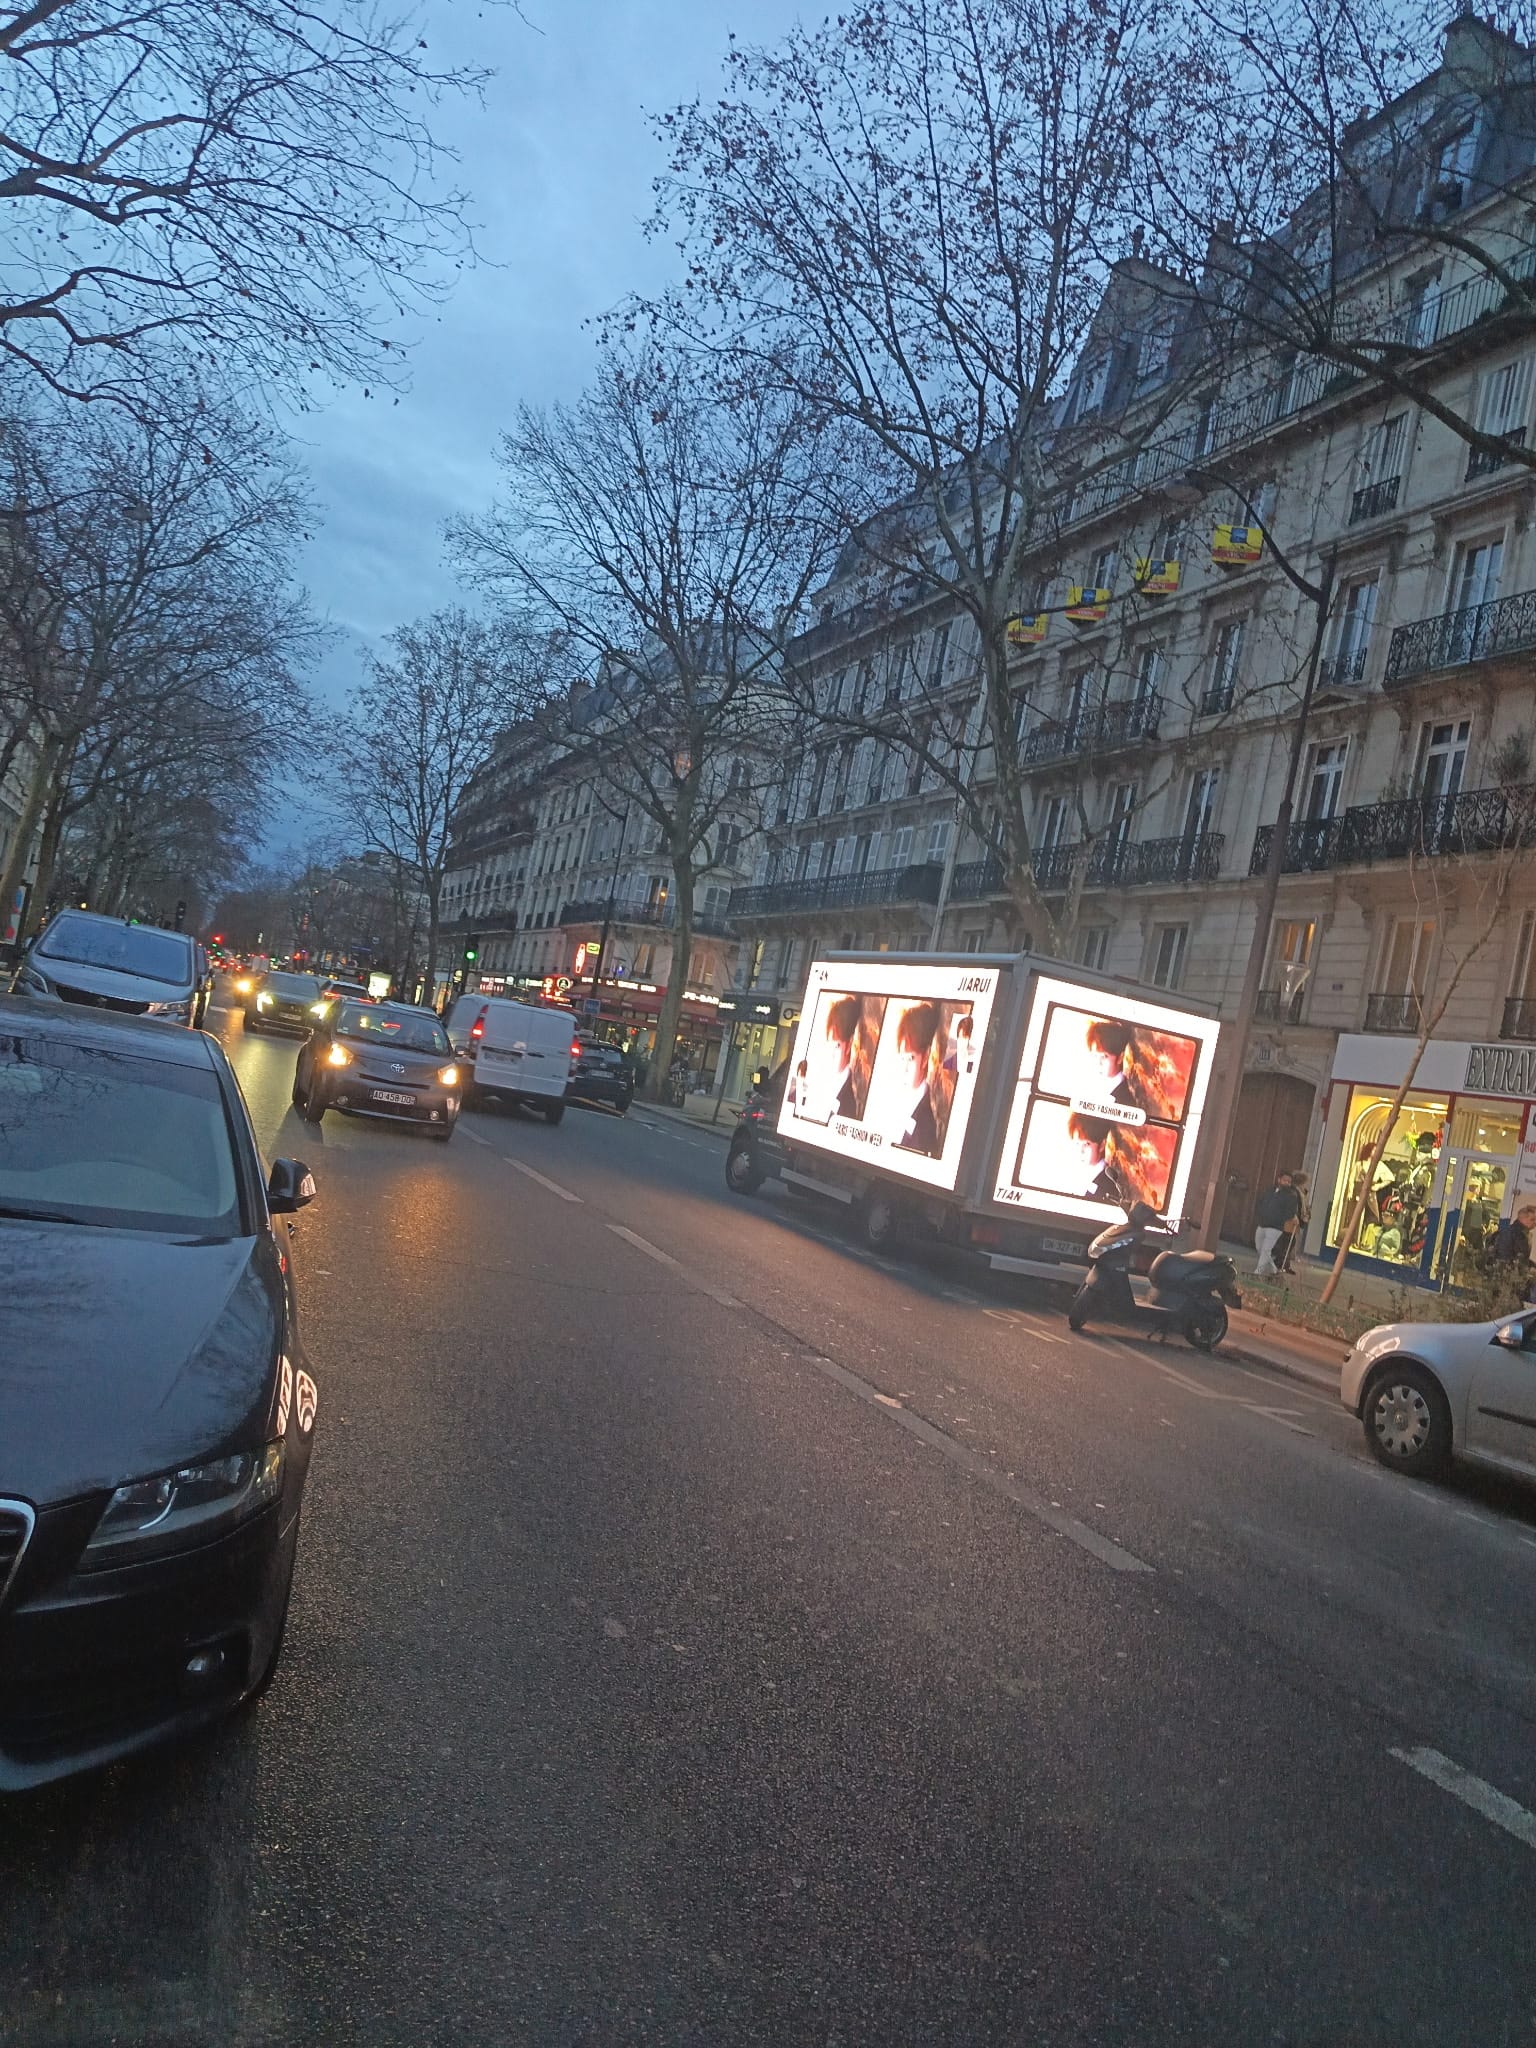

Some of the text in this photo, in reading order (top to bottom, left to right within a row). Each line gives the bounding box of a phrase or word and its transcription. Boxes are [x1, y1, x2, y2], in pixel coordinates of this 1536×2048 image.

[957, 976, 992, 993] JIARUI
[1463, 1046, 1536, 1096] EXTRAV
[1079, 1100, 1096, 1112] PARIS
[996, 1187, 1023, 1202] TIAN
